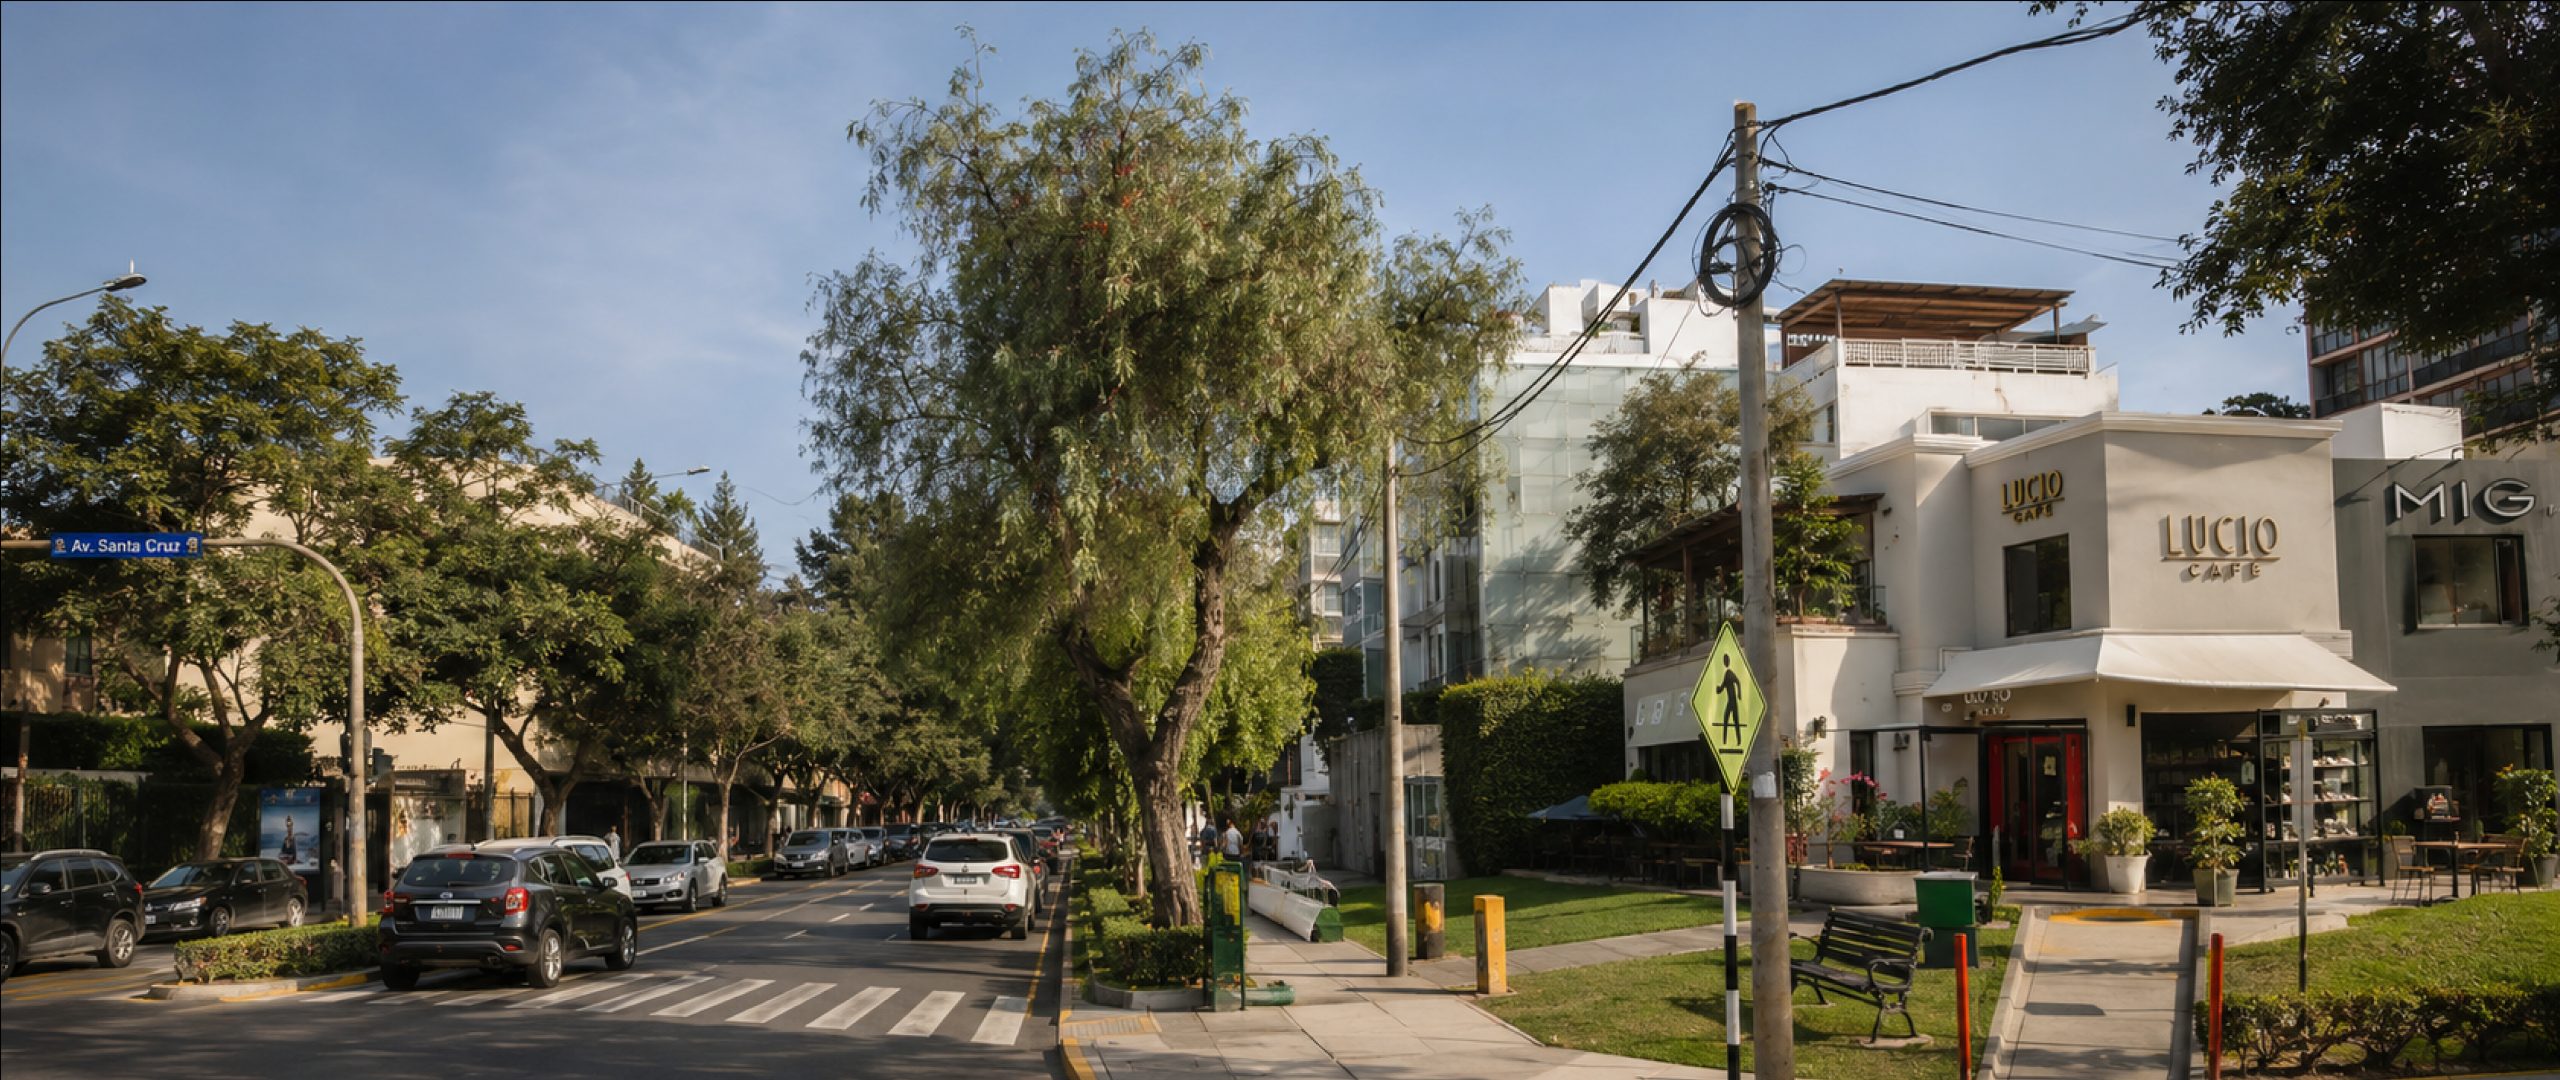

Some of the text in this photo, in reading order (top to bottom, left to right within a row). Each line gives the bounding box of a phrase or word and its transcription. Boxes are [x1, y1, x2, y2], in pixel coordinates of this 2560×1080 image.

[2001, 469, 2063, 511] LUCIO
[2392, 477, 2536, 519] MIG
[71, 538, 181, 553] Av. Santa Cruz
[2165, 513, 2279, 555] LUCIO
